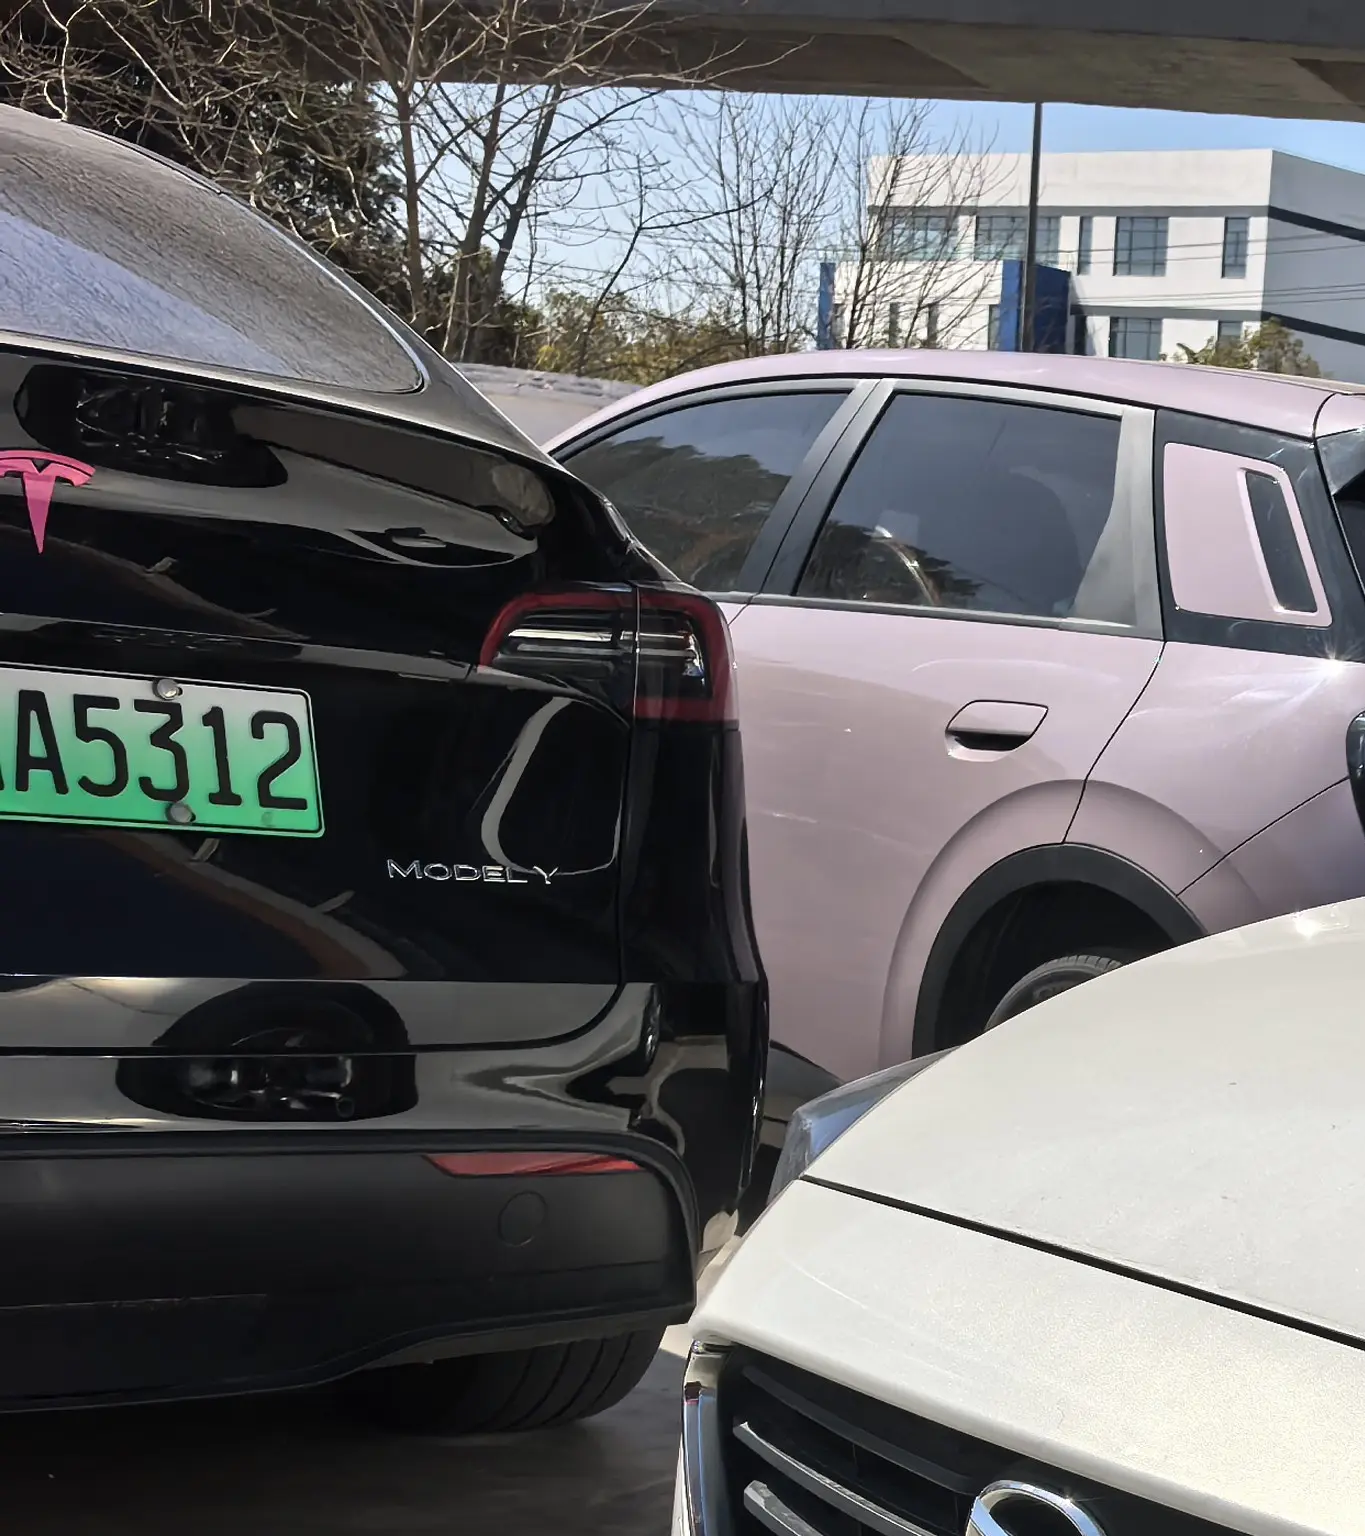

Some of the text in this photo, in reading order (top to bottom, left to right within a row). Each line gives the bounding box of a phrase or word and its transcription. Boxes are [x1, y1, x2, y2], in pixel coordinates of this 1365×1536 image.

[0, 690, 309, 811] A5312
[386, 858, 559, 885] MODEL Y
